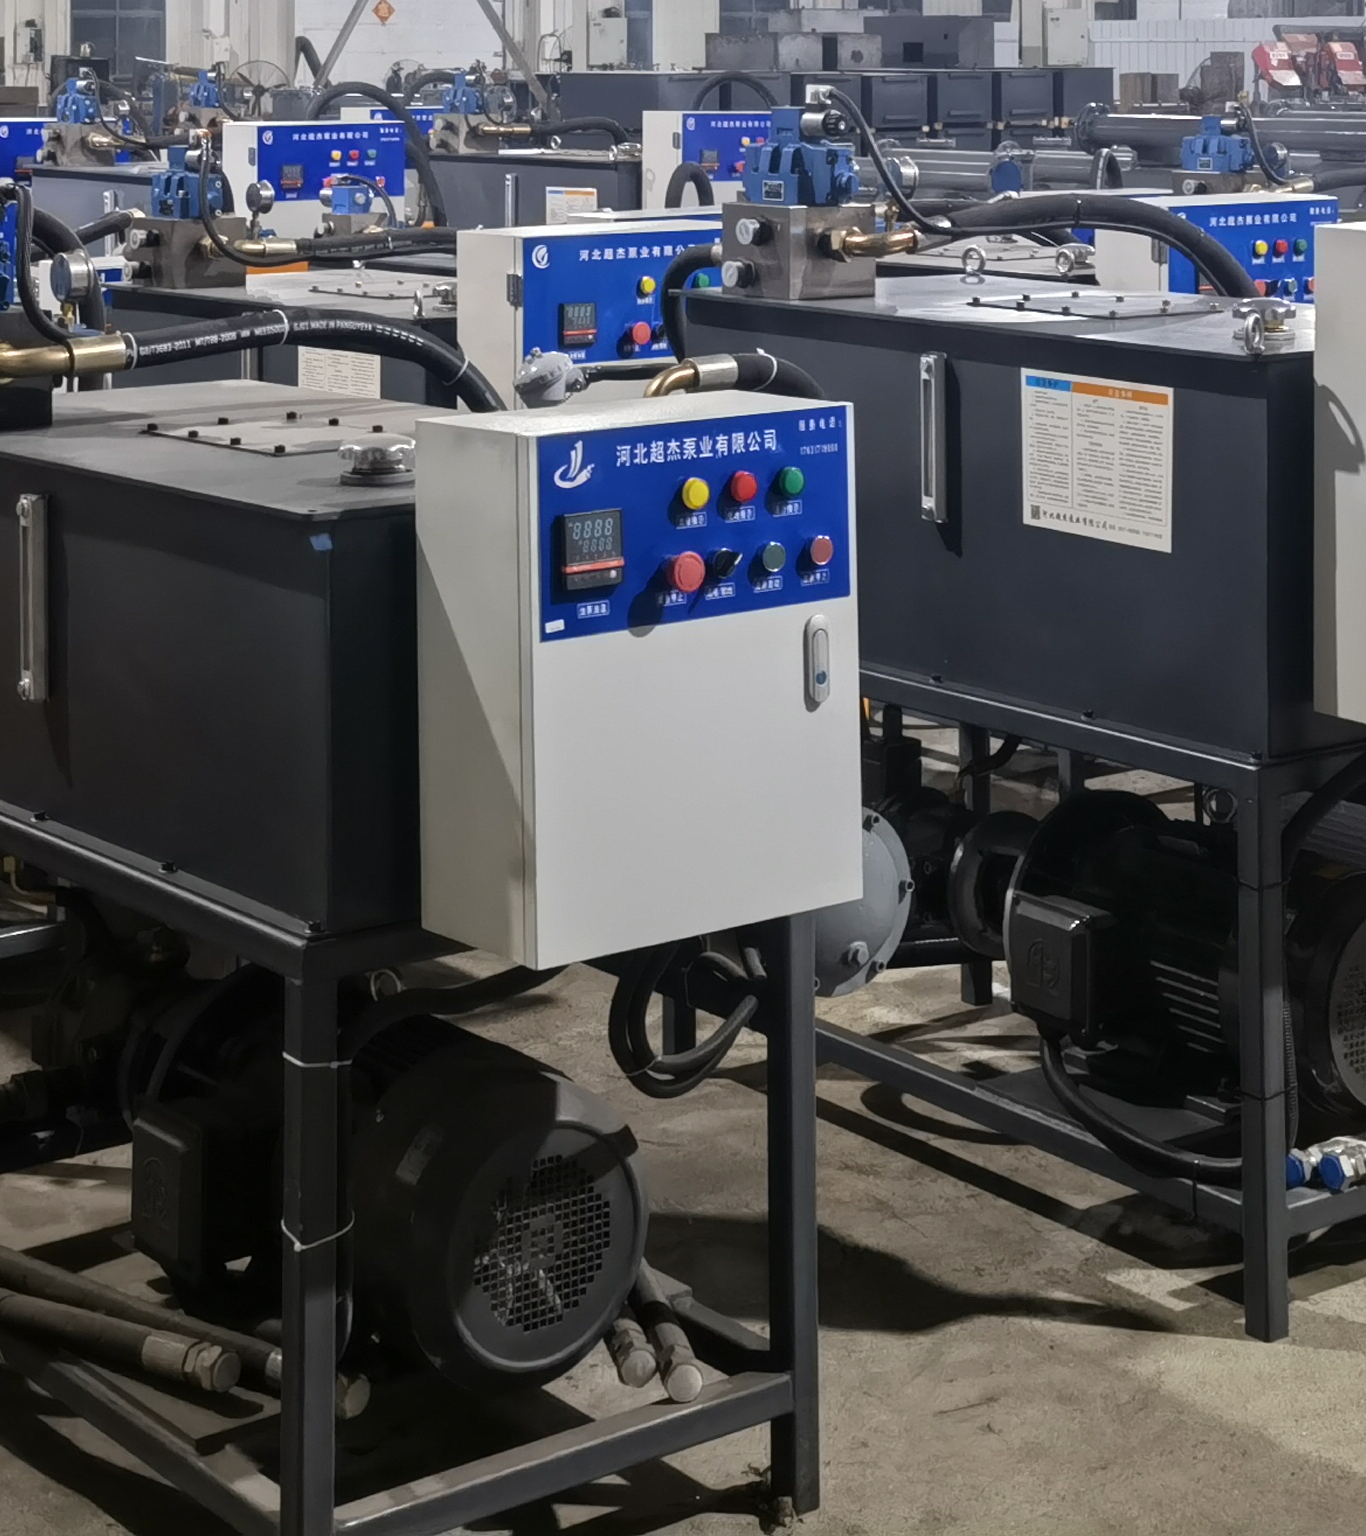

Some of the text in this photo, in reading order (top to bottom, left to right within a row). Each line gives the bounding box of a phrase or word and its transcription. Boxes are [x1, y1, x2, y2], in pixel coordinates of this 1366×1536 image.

[579, 244, 696, 262] 河北超杰泵业有限公
[616, 429, 777, 467] 河北超杰泵业有限公司
